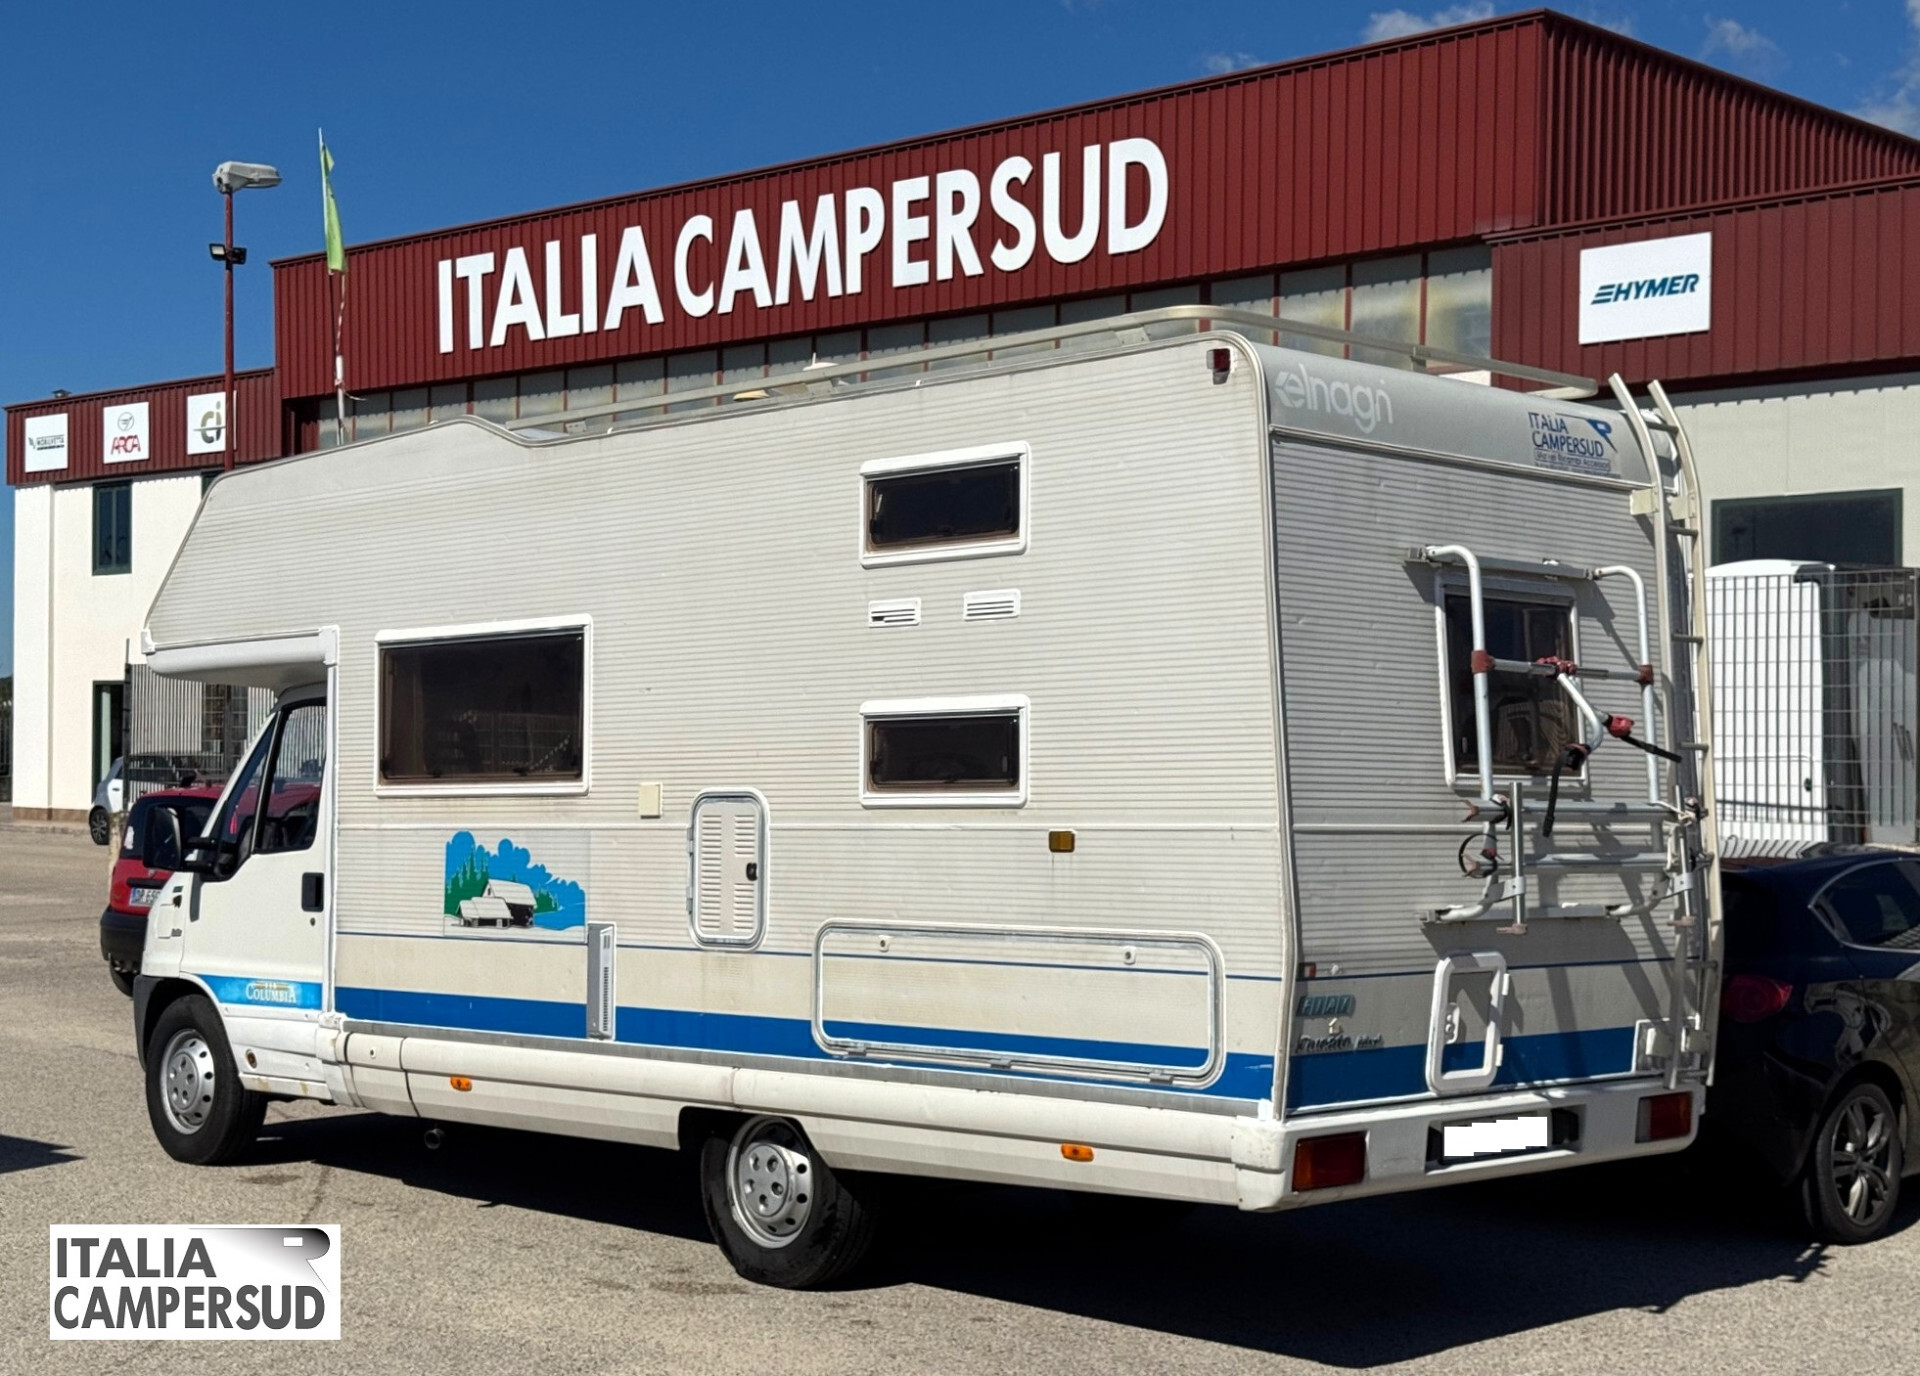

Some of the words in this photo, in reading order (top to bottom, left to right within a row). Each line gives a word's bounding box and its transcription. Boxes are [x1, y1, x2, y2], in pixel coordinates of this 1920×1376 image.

[437, 225, 665, 354] ITALIA
[673, 136, 1170, 318] CAMPERSUD
[1611, 272, 1700, 303] HYMER
[1528, 411, 1569, 434] ITALIA
[110, 434, 141, 455] ARCA
[1532, 430, 1604, 457] CAMPERSUD
